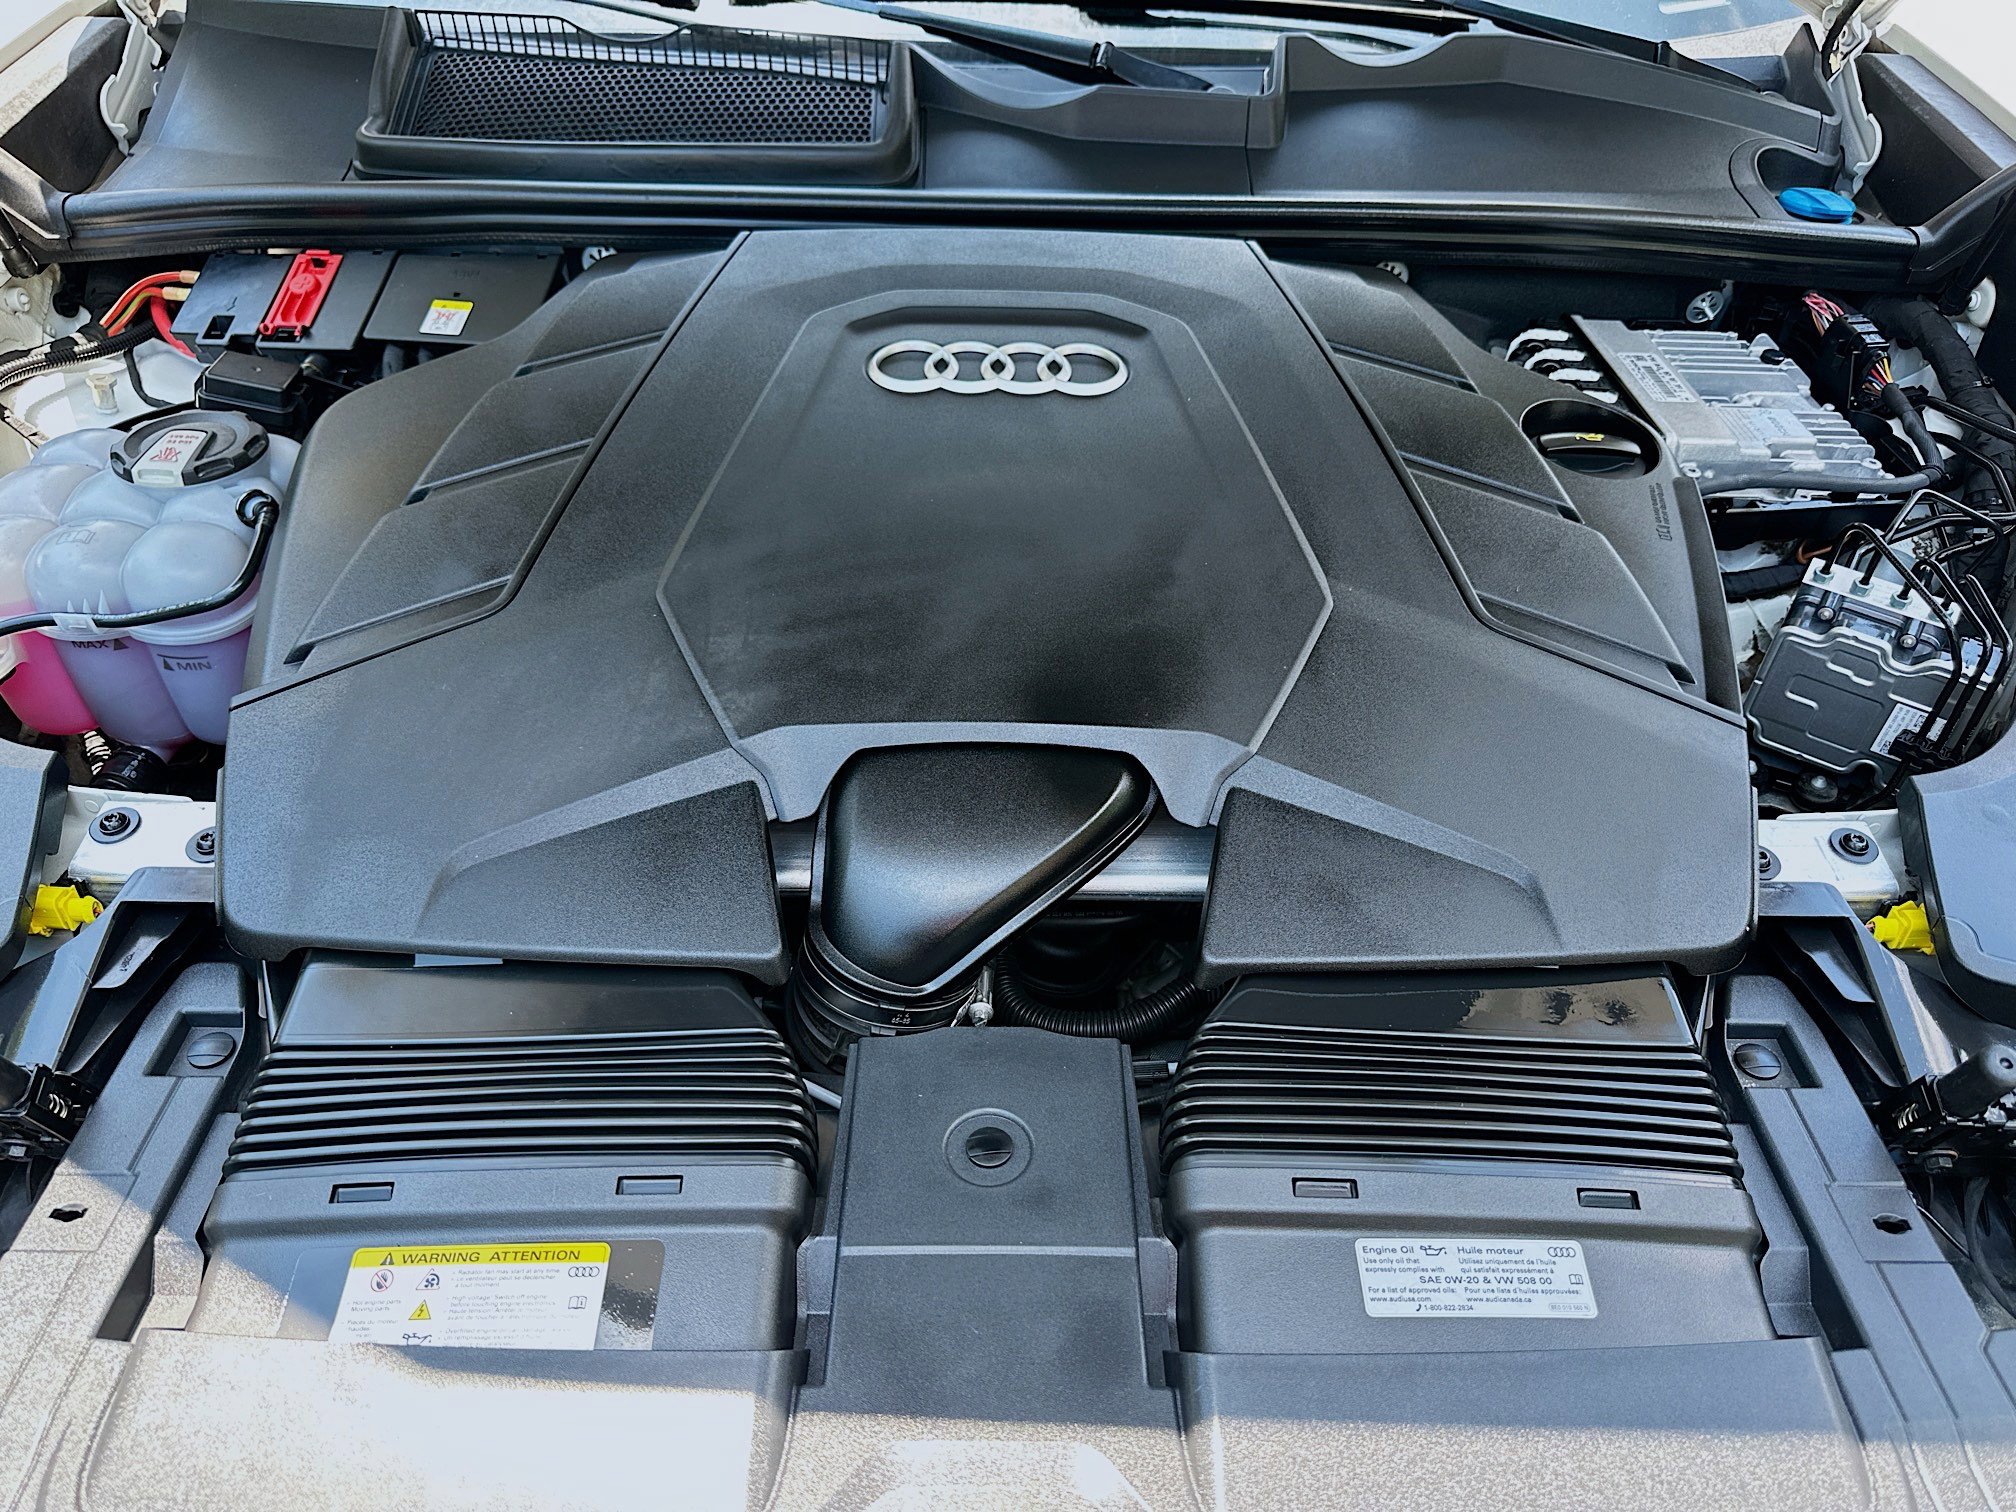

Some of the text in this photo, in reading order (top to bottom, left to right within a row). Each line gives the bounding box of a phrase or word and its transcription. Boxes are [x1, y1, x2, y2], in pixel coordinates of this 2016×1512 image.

[71, 639, 109, 649] MAX
[176, 661, 212, 671] MIN
[1362, 1245, 1415, 1256] Engine Oil
[1456, 1246, 1524, 1255] Huile moteur
[402, 1250, 581, 1264] WARNING ATTENTION
[1379, 1257, 1394, 1265] only
[1485, 1258, 1526, 1266] uniquement
[1365, 1266, 1397, 1274] expressly
[1398, 1266, 1429, 1274] complies
[1419, 1275, 1553, 1285] SAE 0W-20 & VW 508 00
[1408, 1286, 1441, 1295] approved
[1464, 1286, 1481, 1294] Pour
[1496, 1286, 1511, 1294] liste
[1512, 1286, 1539, 1294] d'huiles
[1370, 1295, 1432, 1303] www.audiusa.com
